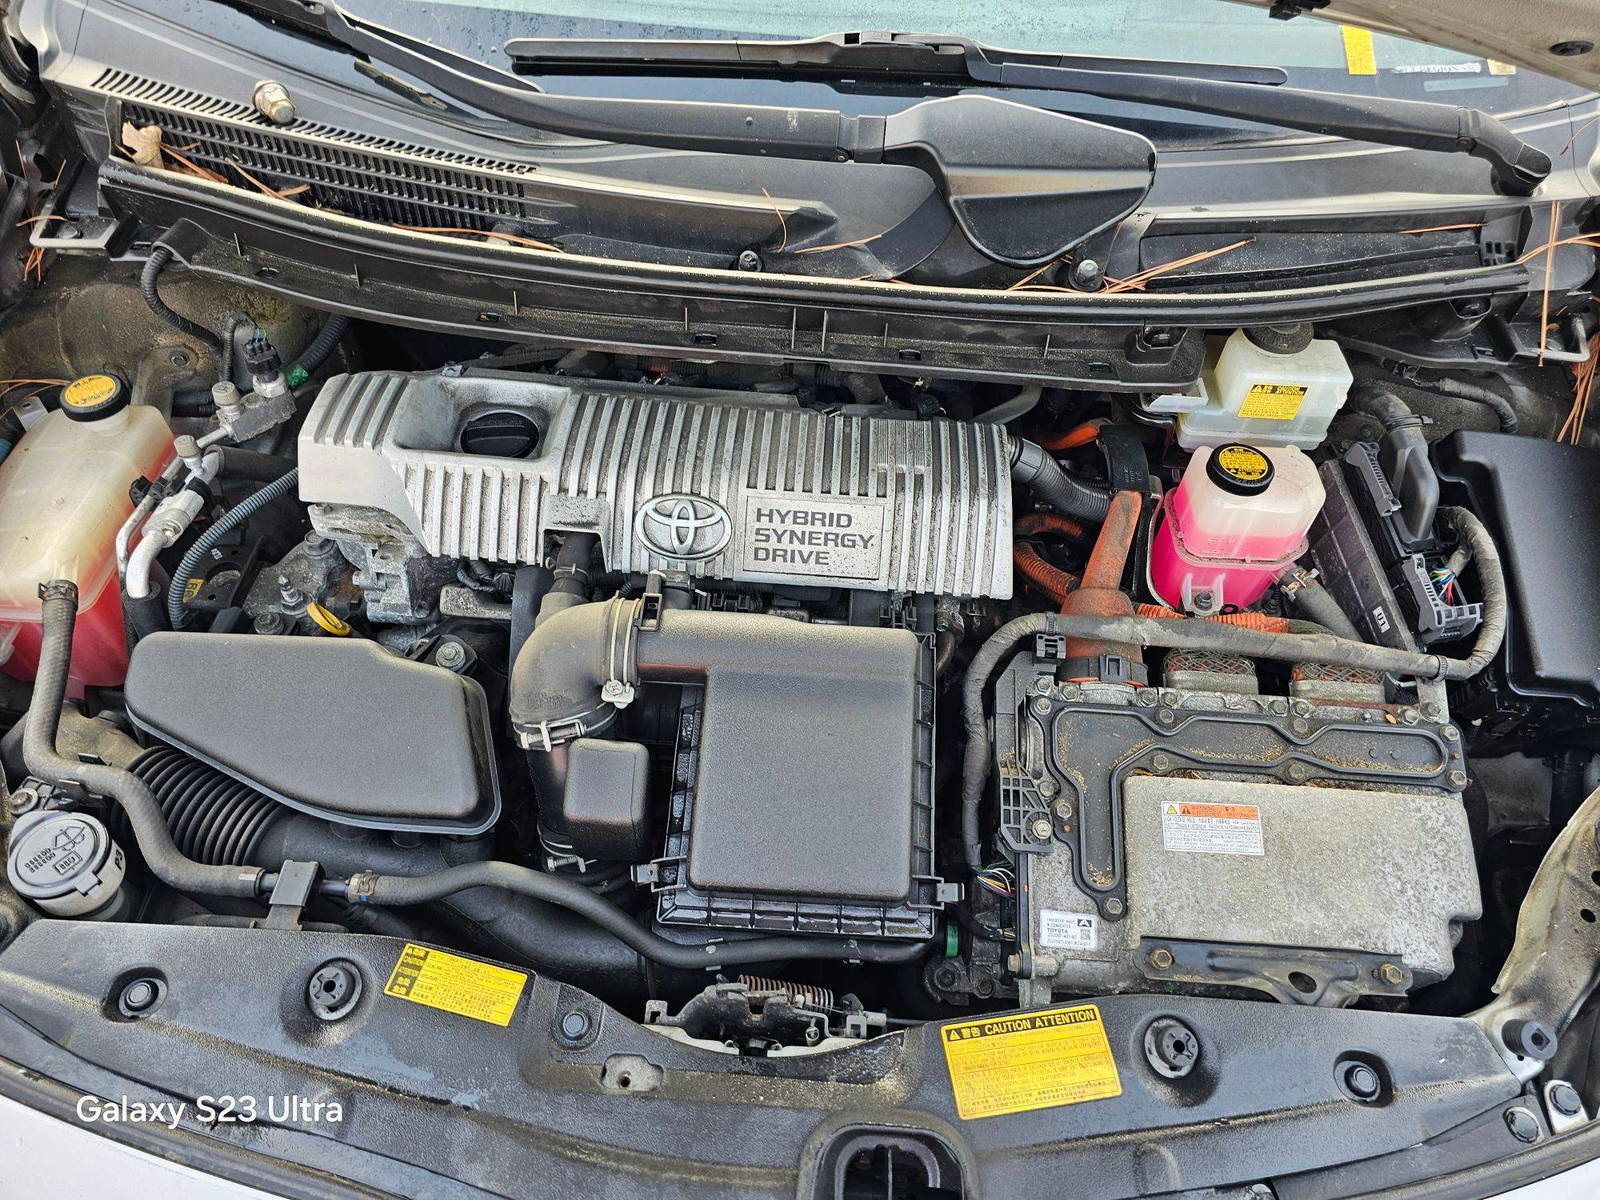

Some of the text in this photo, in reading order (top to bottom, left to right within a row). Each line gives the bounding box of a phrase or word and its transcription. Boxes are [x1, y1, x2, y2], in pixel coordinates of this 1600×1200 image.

[756, 508, 853, 528] HYBRID
[754, 527, 875, 549] SYNERGY
[753, 547, 830, 565] DRIVE
[984, 1009, 1096, 1036] CAUTION ATTENTION
